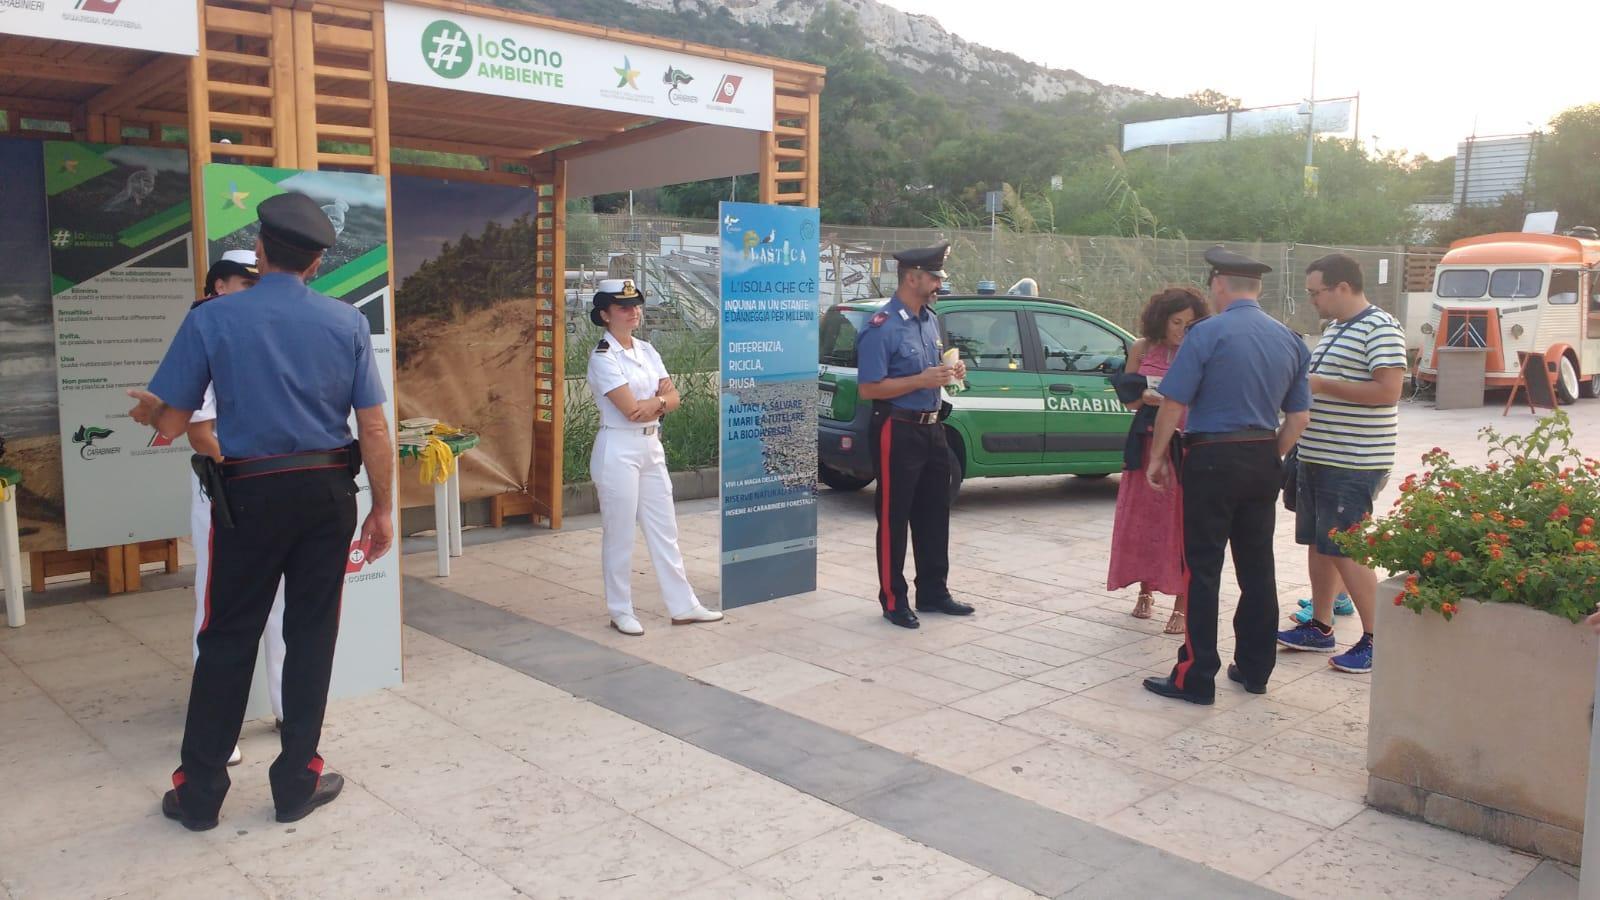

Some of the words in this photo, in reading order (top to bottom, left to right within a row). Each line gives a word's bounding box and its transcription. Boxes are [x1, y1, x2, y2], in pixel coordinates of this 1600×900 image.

[477, 61, 565, 88] AMBIENTE
[731, 280, 773, 293] L'ISOLA
[775, 281, 796, 293] CHE
[798, 278, 815, 293] C'È
[725, 299, 757, 312] INQUINA
[758, 300, 766, 310] IN
[767, 299, 780, 310] UN
[781, 299, 809, 310] ISTANTE
[725, 311, 730, 322] E
[731, 311, 770, 322] DANNEGGIA
[772, 311, 784, 322] PER
[785, 311, 814, 322] MILLENNI
[729, 341, 784, 353] DIFFERENZIA,
[729, 359, 764, 371] RICICLA,
[729, 378, 756, 389] RIUSA
[729, 403, 760, 414] AIUTACI
[770, 400, 802, 411] SALVARE
[732, 416, 753, 427] MARI
[768, 412, 805, 424] TUTELARE
[729, 430, 739, 440] LA
[86, 446, 121, 456] CARABINIERI
[761, 475, 777, 483] DELLA
[725, 492, 753, 504] RISERVE
[753, 501, 786, 512] CARABINIERI
